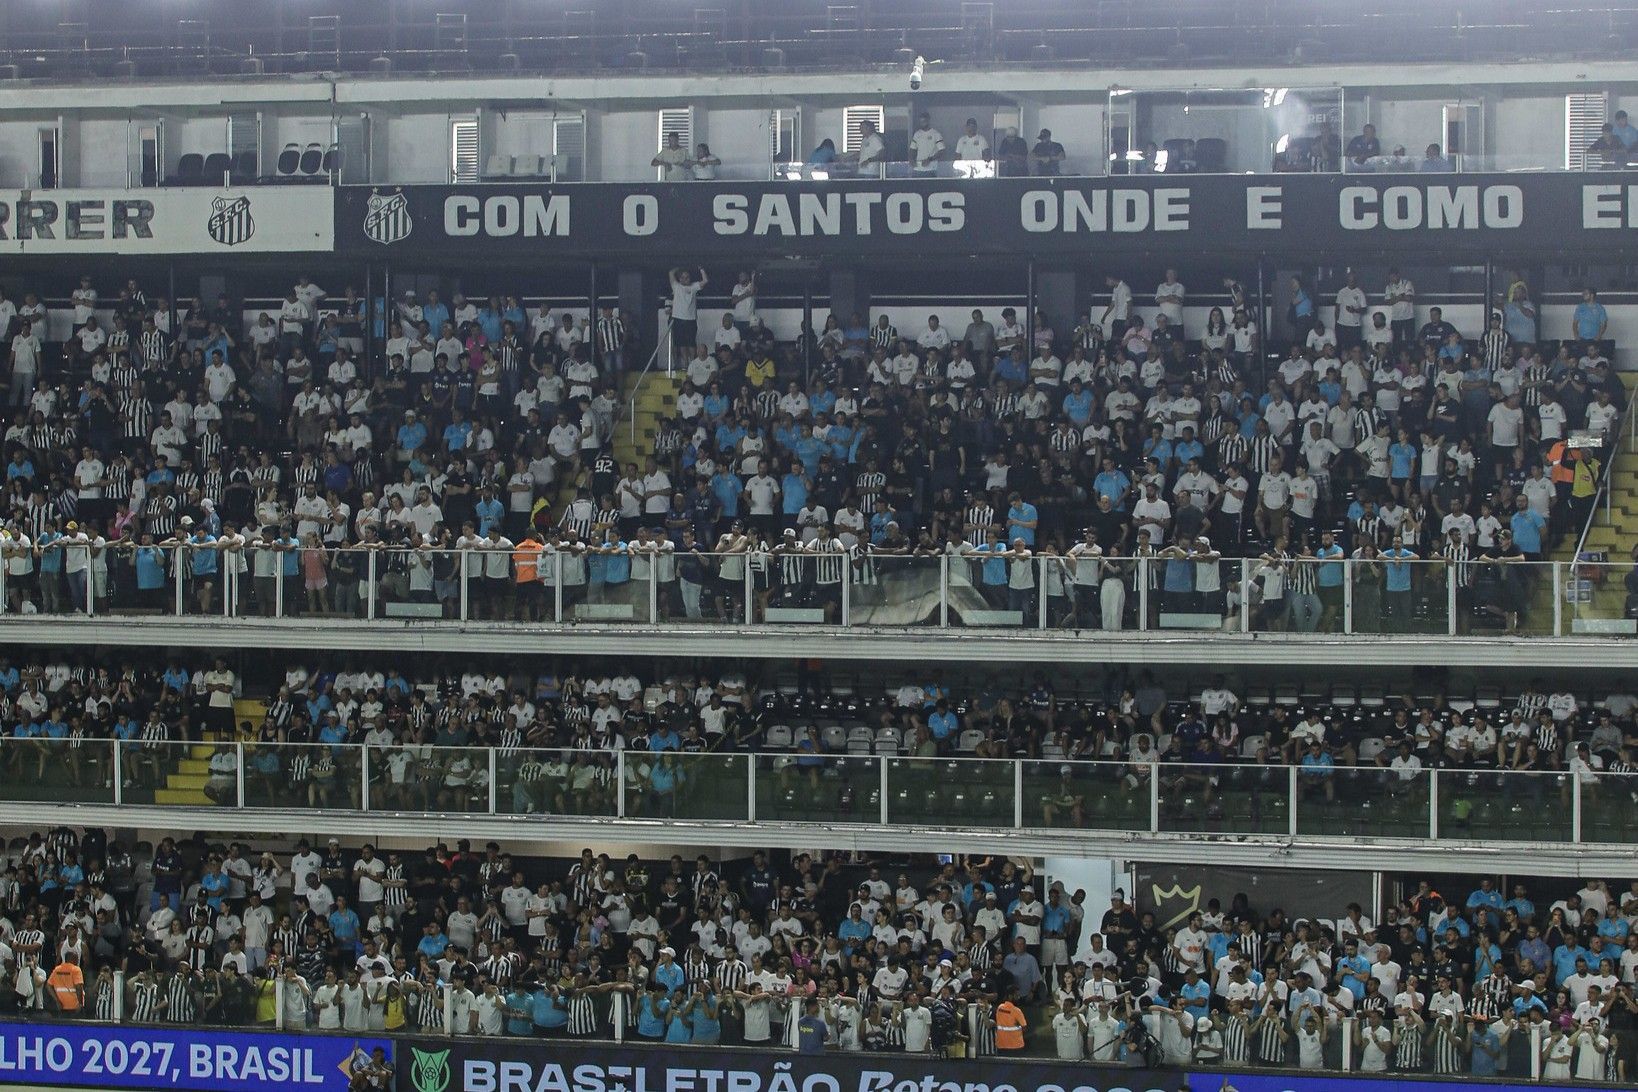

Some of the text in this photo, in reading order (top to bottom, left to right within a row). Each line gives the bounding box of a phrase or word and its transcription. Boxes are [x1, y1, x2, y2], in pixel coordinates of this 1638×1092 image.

[0, 200, 155, 240] RER
[445, 185, 1638, 236] COM O SANTOS ONDE E COMO E
[0, 1036, 324, 1083] LHO 2027, BRASIL
